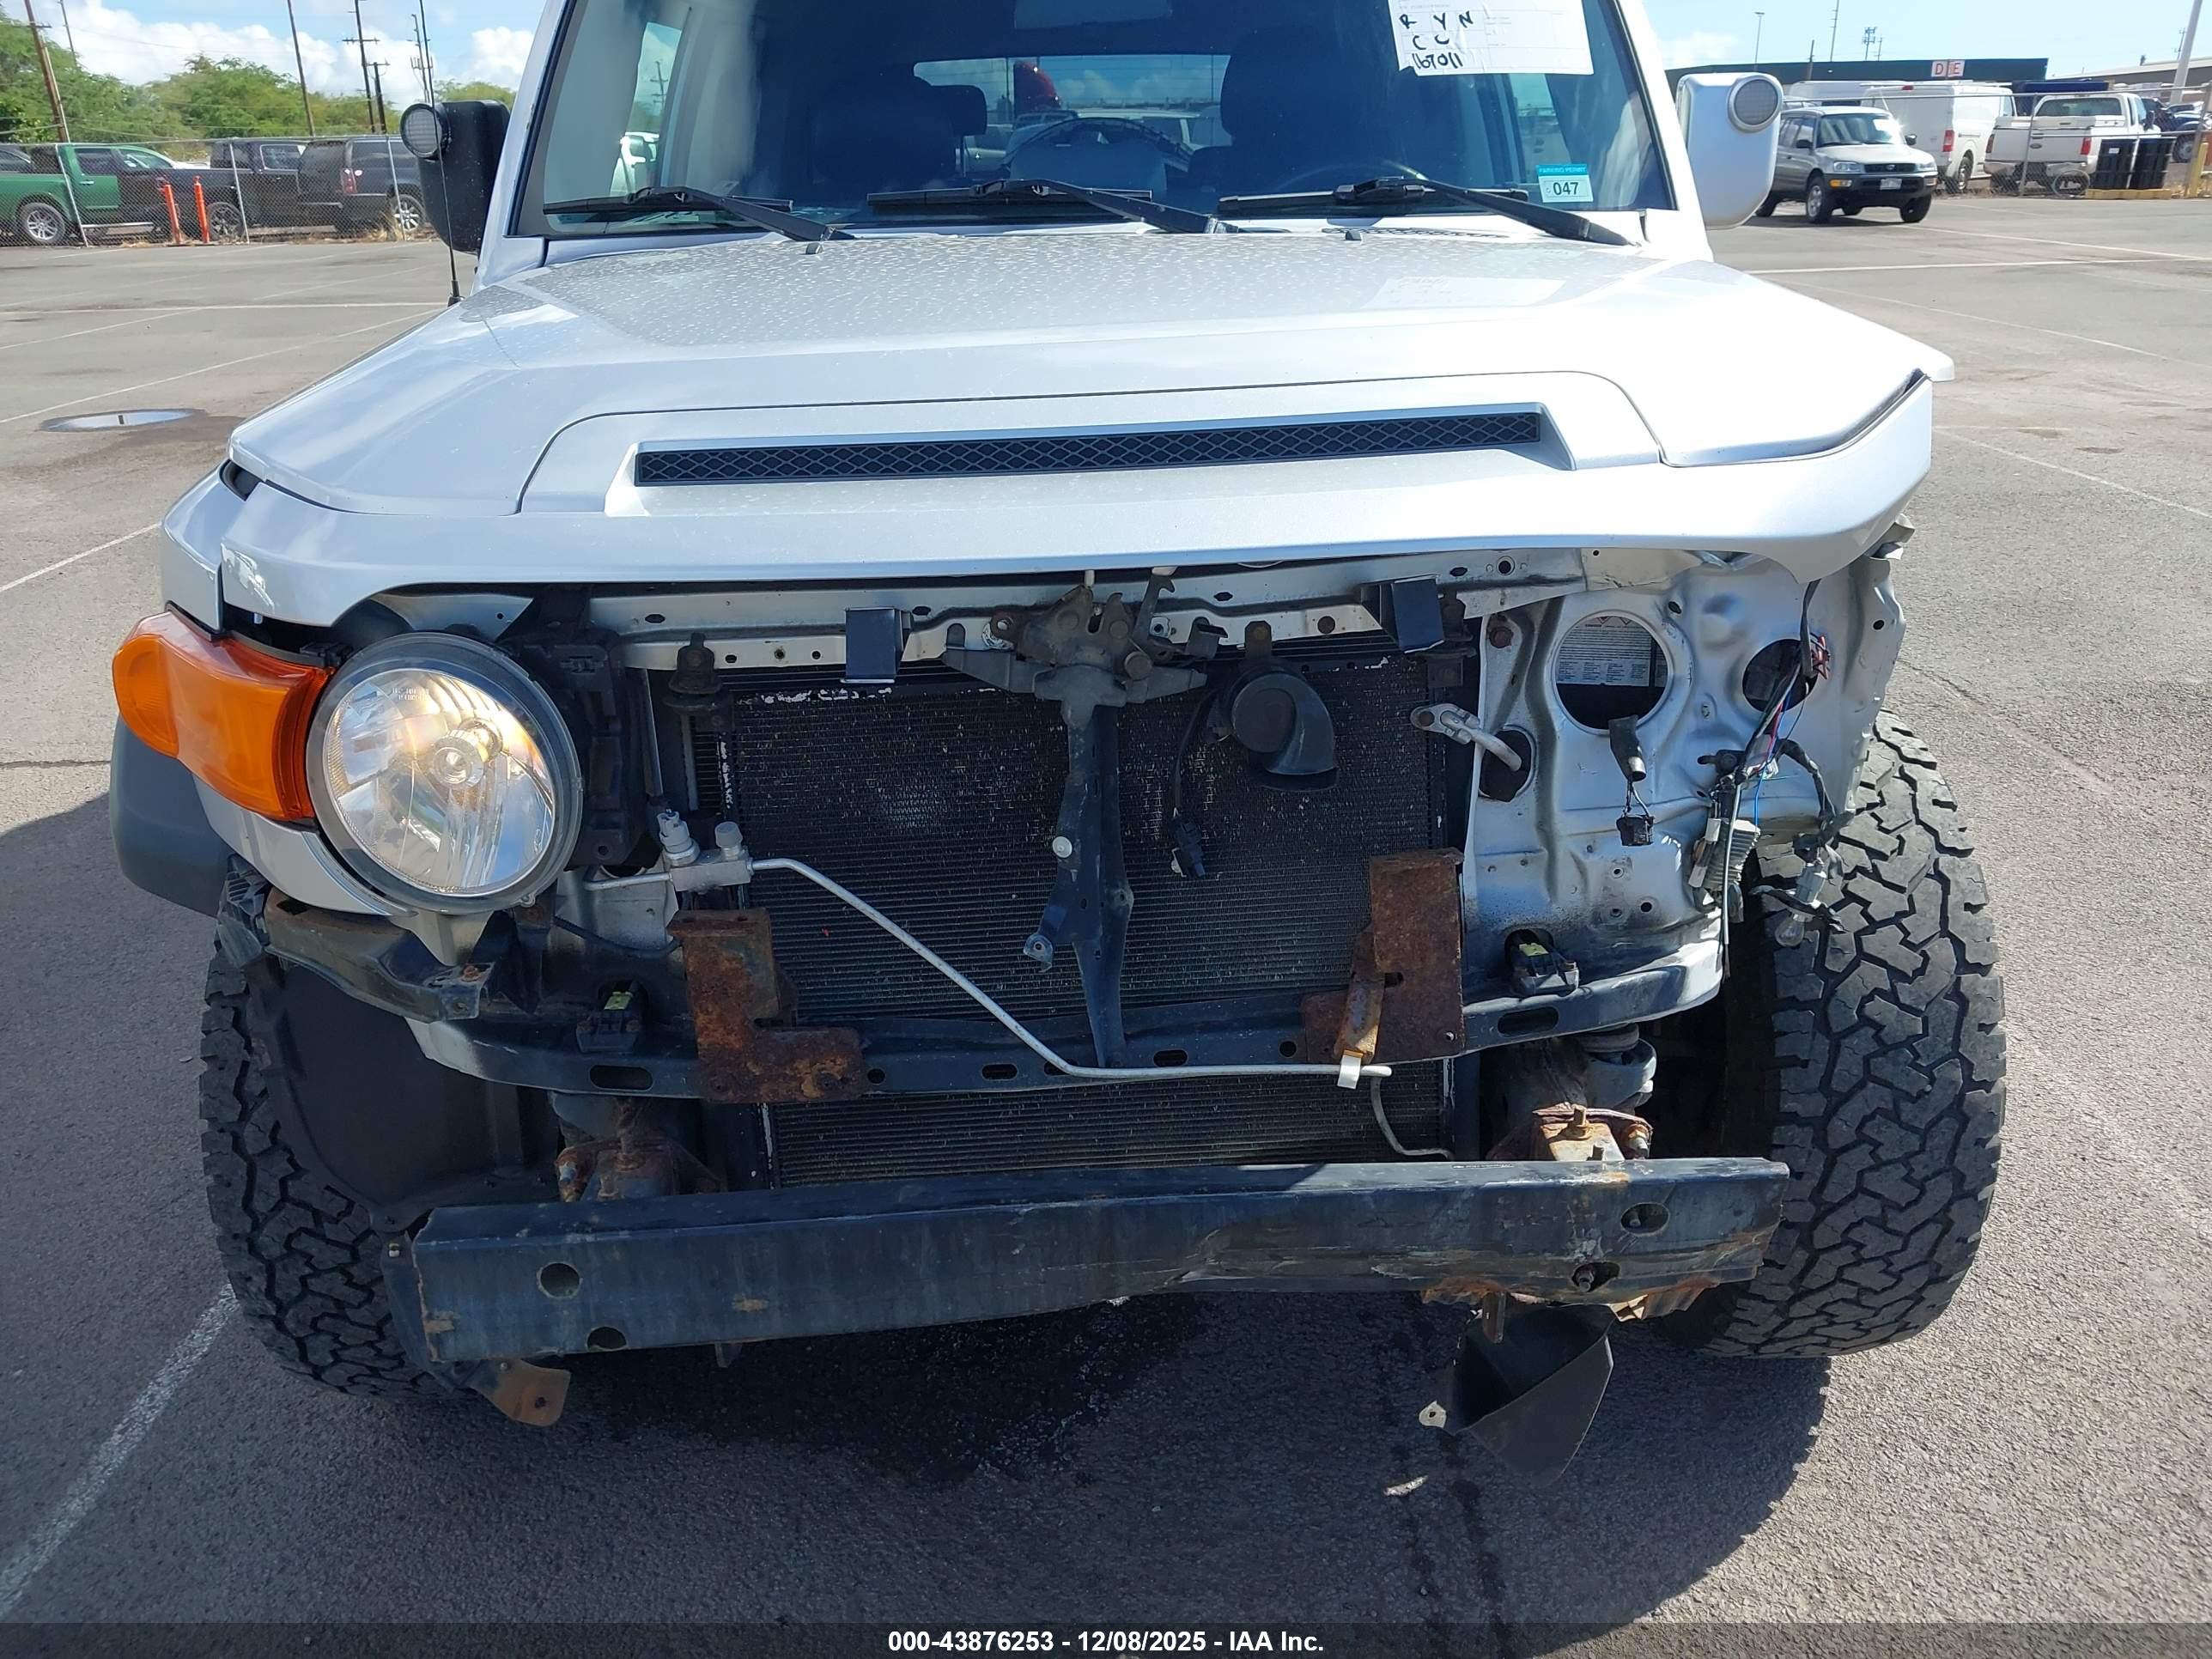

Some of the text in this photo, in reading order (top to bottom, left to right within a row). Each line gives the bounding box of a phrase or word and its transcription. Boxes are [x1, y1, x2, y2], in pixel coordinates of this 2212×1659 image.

[1399, 13, 1418, 30] R
[1432, 11, 1447, 31] Y
[1458, 9, 1474, 29] N
[1936, 63, 1943, 75] D
[1553, 181, 1579, 196] 047
